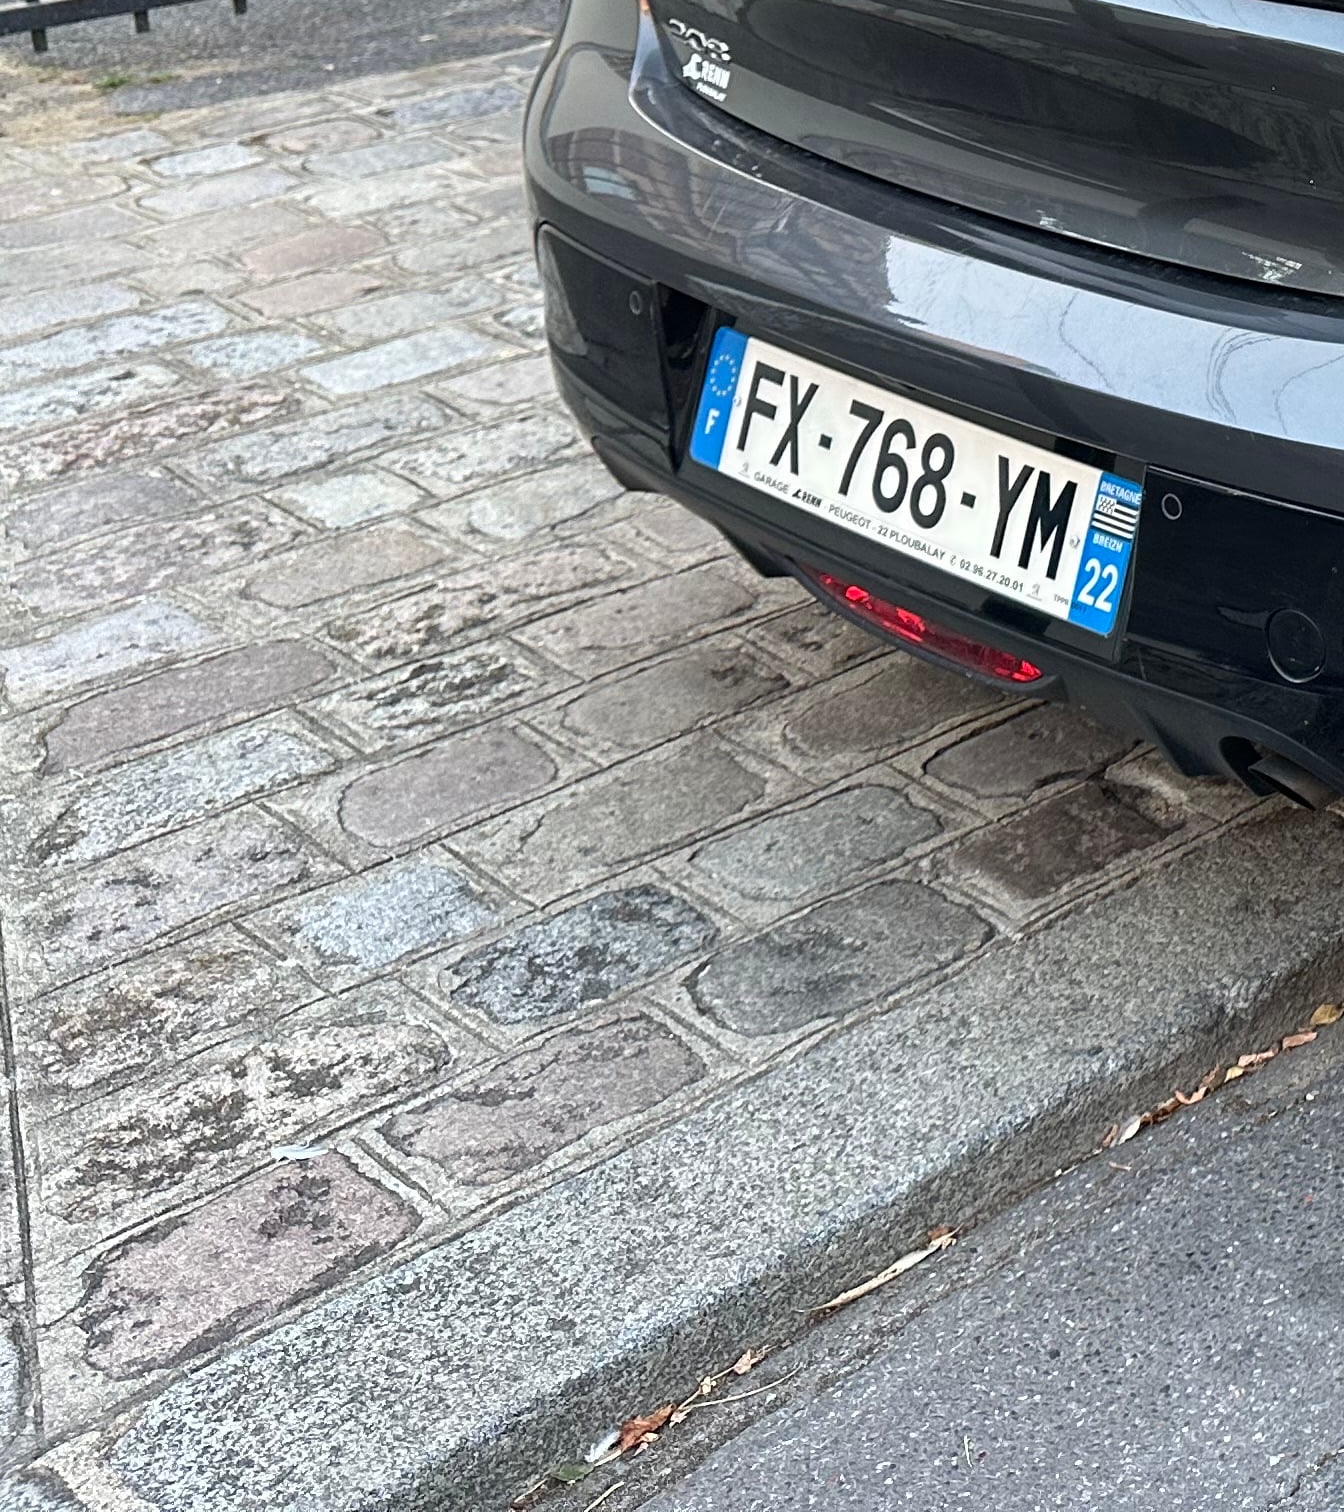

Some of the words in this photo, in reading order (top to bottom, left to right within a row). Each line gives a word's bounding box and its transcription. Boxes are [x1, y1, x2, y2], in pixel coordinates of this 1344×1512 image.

[704, 408, 720, 436] F
[735, 361, 1079, 581] FX-768-YM
[1100, 480, 1142, 505] BRETAGNE
[753, 470, 790, 495] GARAGE
[828, 503, 872, 531] PEUGEOT
[876, 524, 890, 538] 22
[888, 529, 947, 561] PLOUBALAY
[1092, 531, 1124, 554] BREIZH
[1077, 557, 1119, 614] 22
